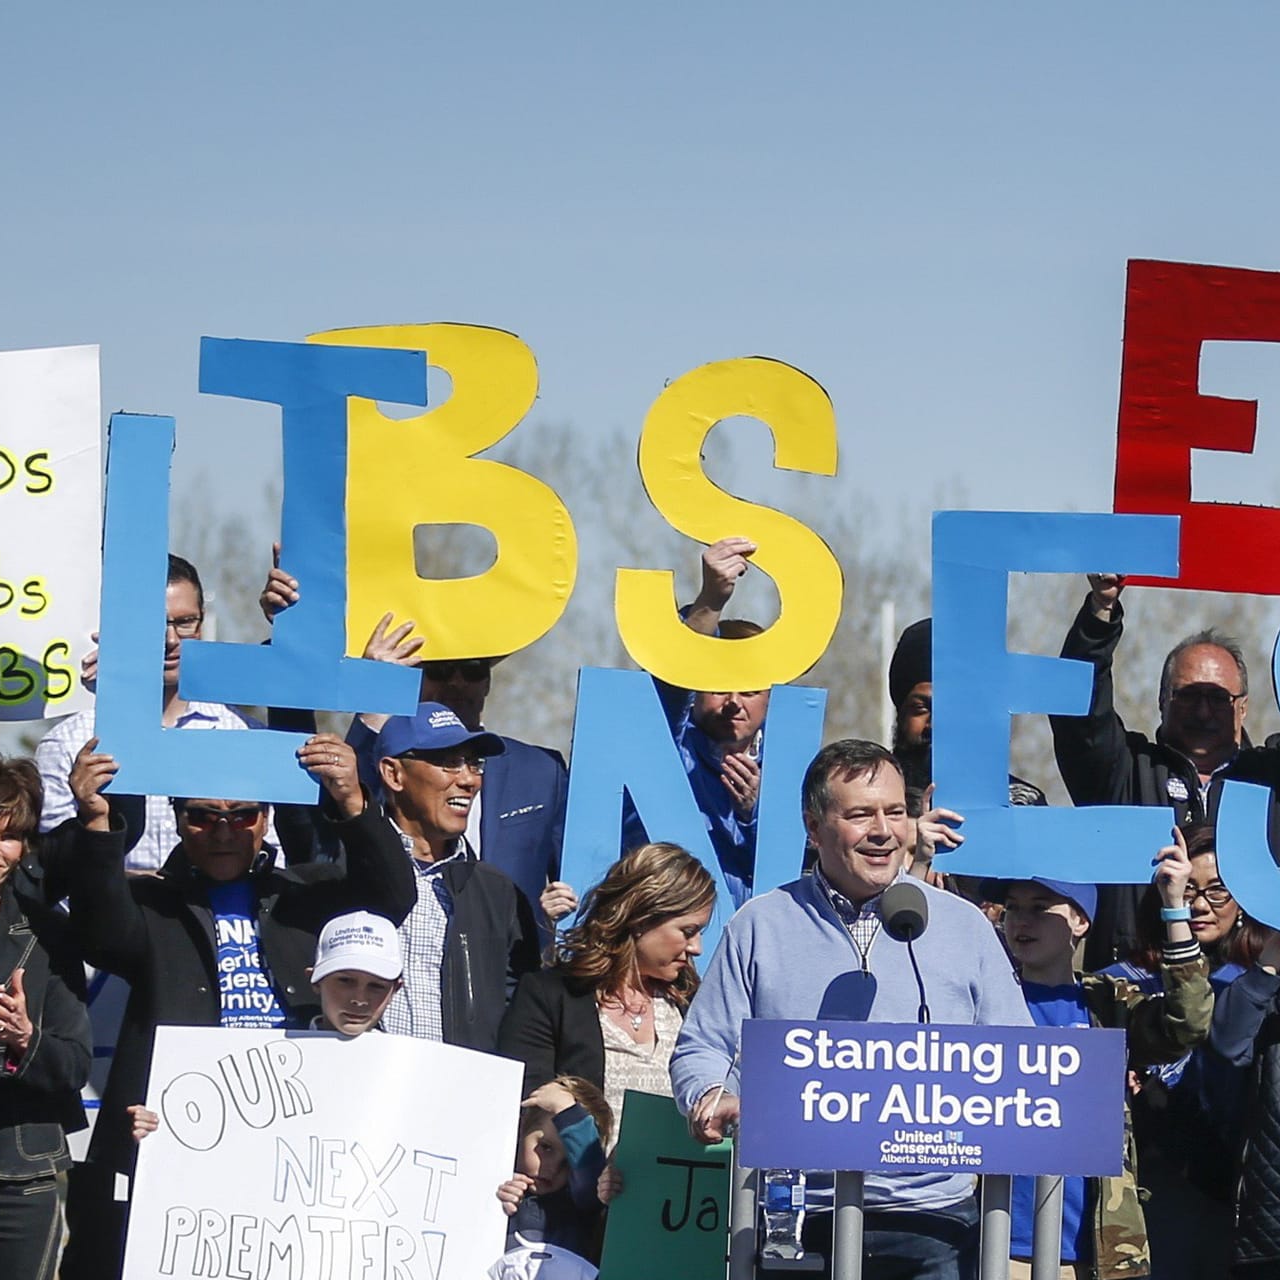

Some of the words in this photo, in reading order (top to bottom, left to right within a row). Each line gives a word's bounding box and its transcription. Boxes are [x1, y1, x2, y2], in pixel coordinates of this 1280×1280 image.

[784, 1028, 1003, 1084] Standing
[1018, 1044, 1081, 1086] up
[161, 1040, 313, 1152] OUR
[801, 1081, 871, 1123] for
[878, 1084, 1062, 1128] Alberta
[880, 1141, 983, 1156] Conservatives
[880, 1154, 916, 1164] Alberta
[917, 1154, 949, 1167] Strong
[951, 1156, 959, 1165] &
[960, 1156, 983, 1166] Free
[894, 1130, 944, 1144] United
[274, 1136, 459, 1223] NEXT
